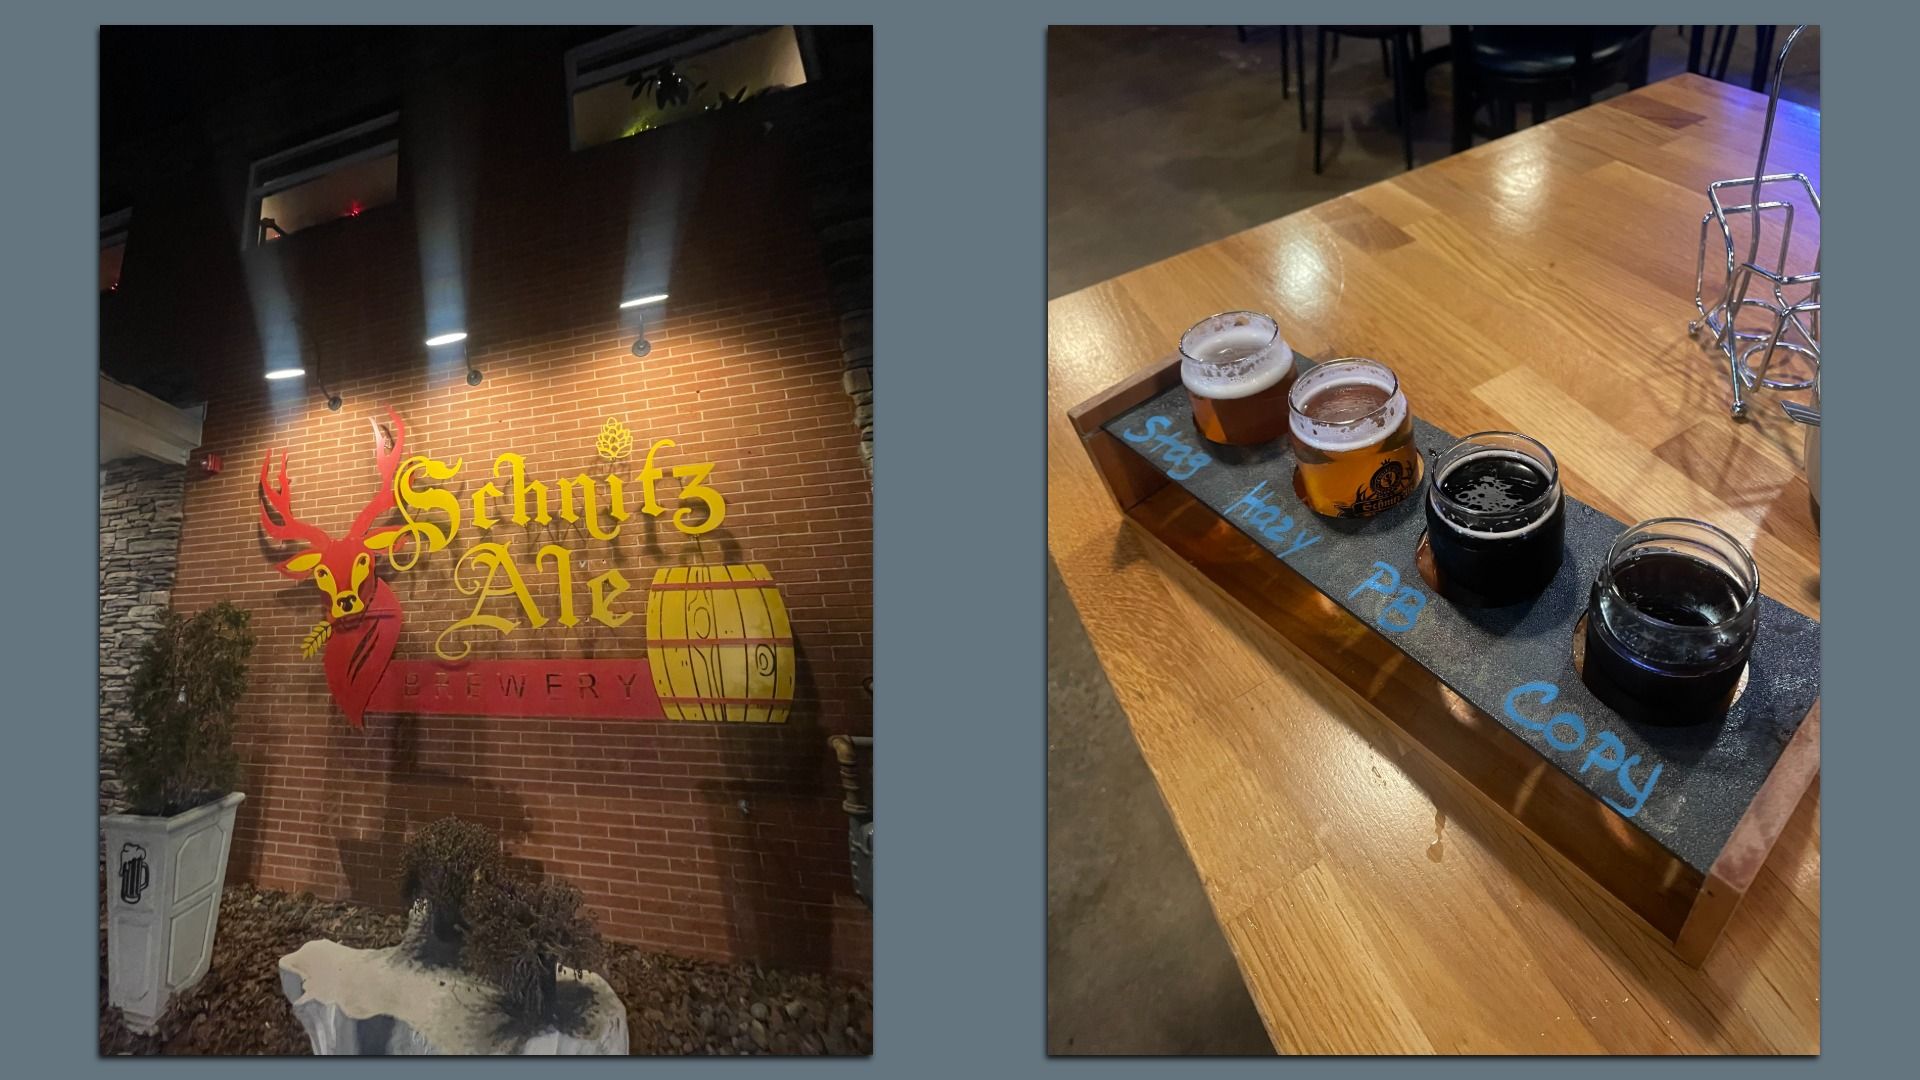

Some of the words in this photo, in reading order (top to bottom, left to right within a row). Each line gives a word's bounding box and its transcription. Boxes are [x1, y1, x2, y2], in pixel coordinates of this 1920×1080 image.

[1123, 415, 1212, 481] Stag
[388, 438, 726, 571] Schnitz
[435, 541, 633, 661] Ale
[1348, 561, 1427, 632] PB
[404, 671, 637, 700] BREWERY
[1503, 681, 1664, 818] Copy
